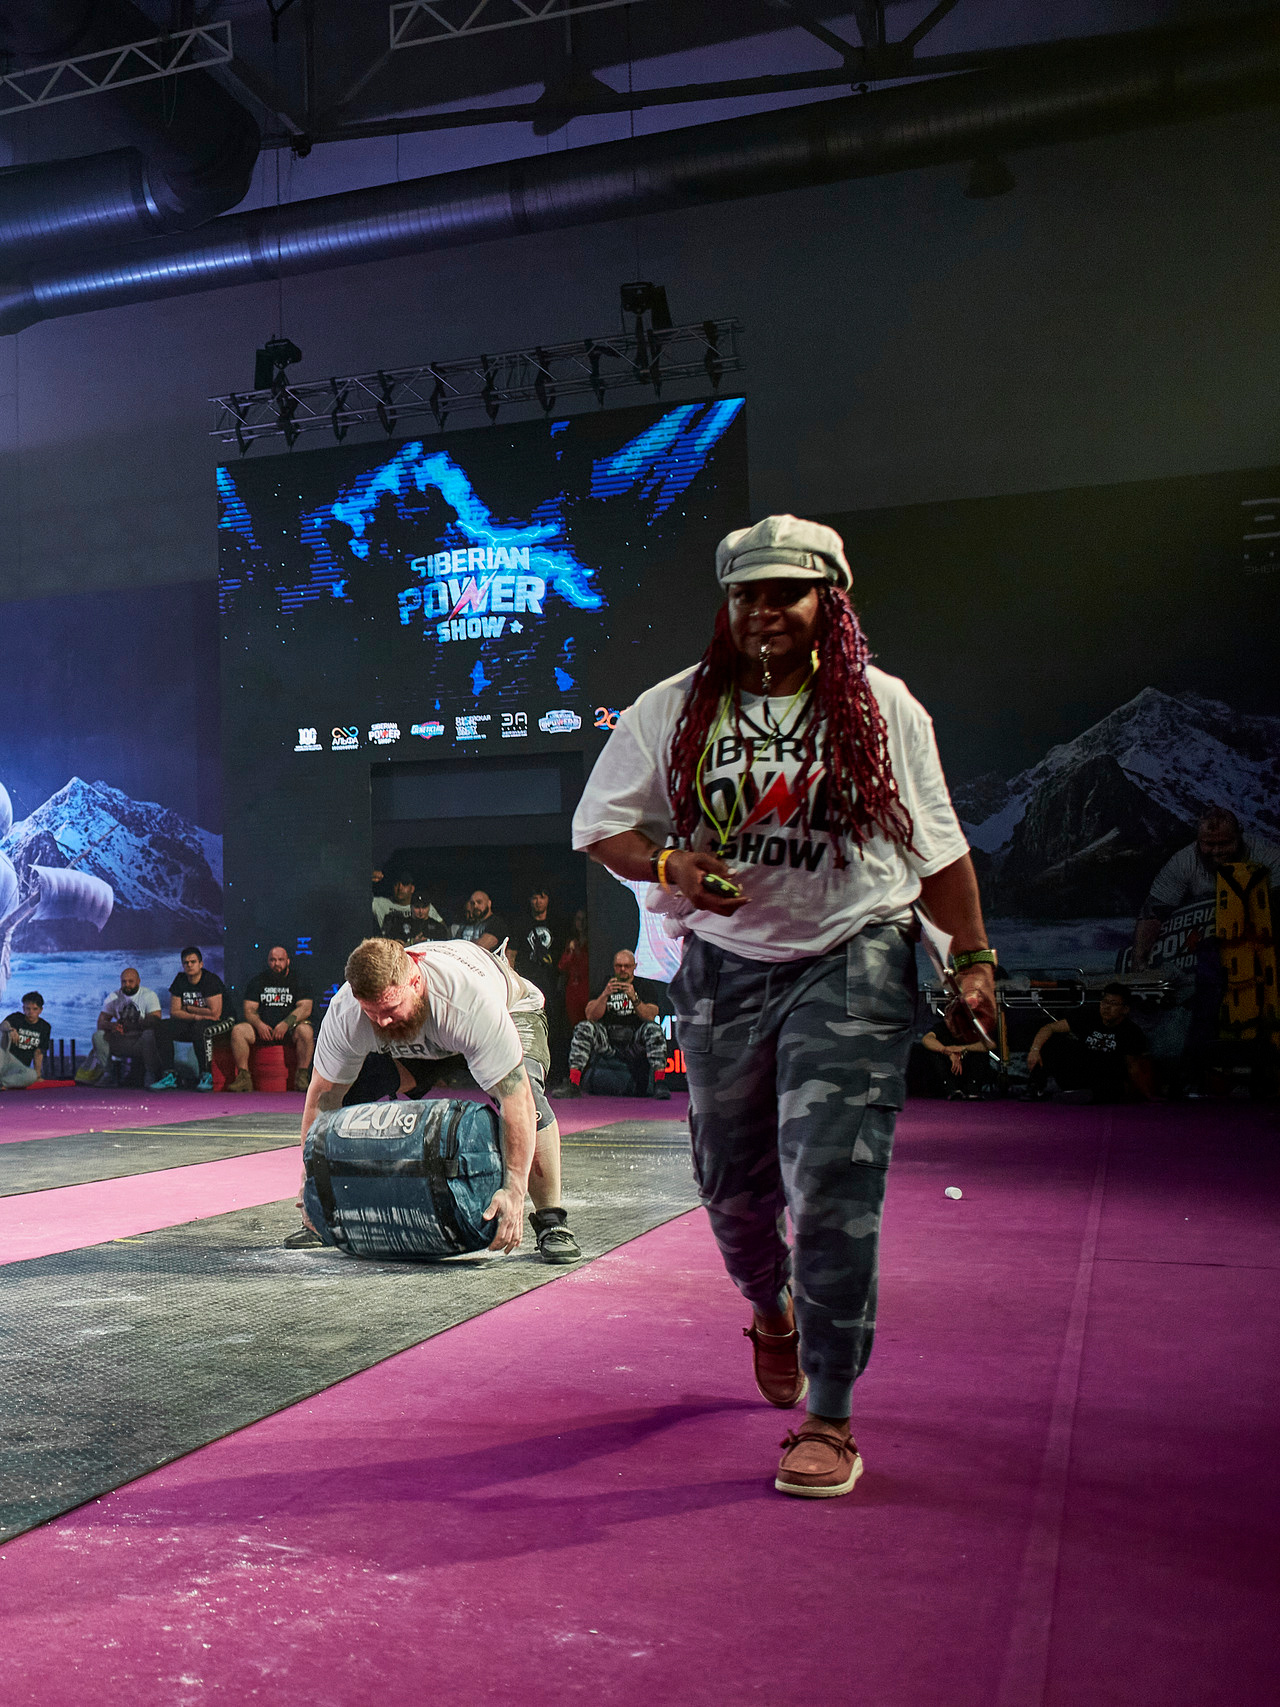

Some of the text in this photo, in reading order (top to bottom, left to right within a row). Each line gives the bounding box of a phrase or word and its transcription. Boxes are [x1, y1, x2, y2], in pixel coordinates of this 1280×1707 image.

[410, 547, 530, 578] SIBERIAN
[397, 574, 545, 625] POWER
[436, 616, 507, 643] SHOW
[331, 737, 359, 746] АЛЬФА
[368, 729, 401, 742] POWER
[260, 993, 293, 1004] POWER
[340, 1102, 418, 1134] 120kg
